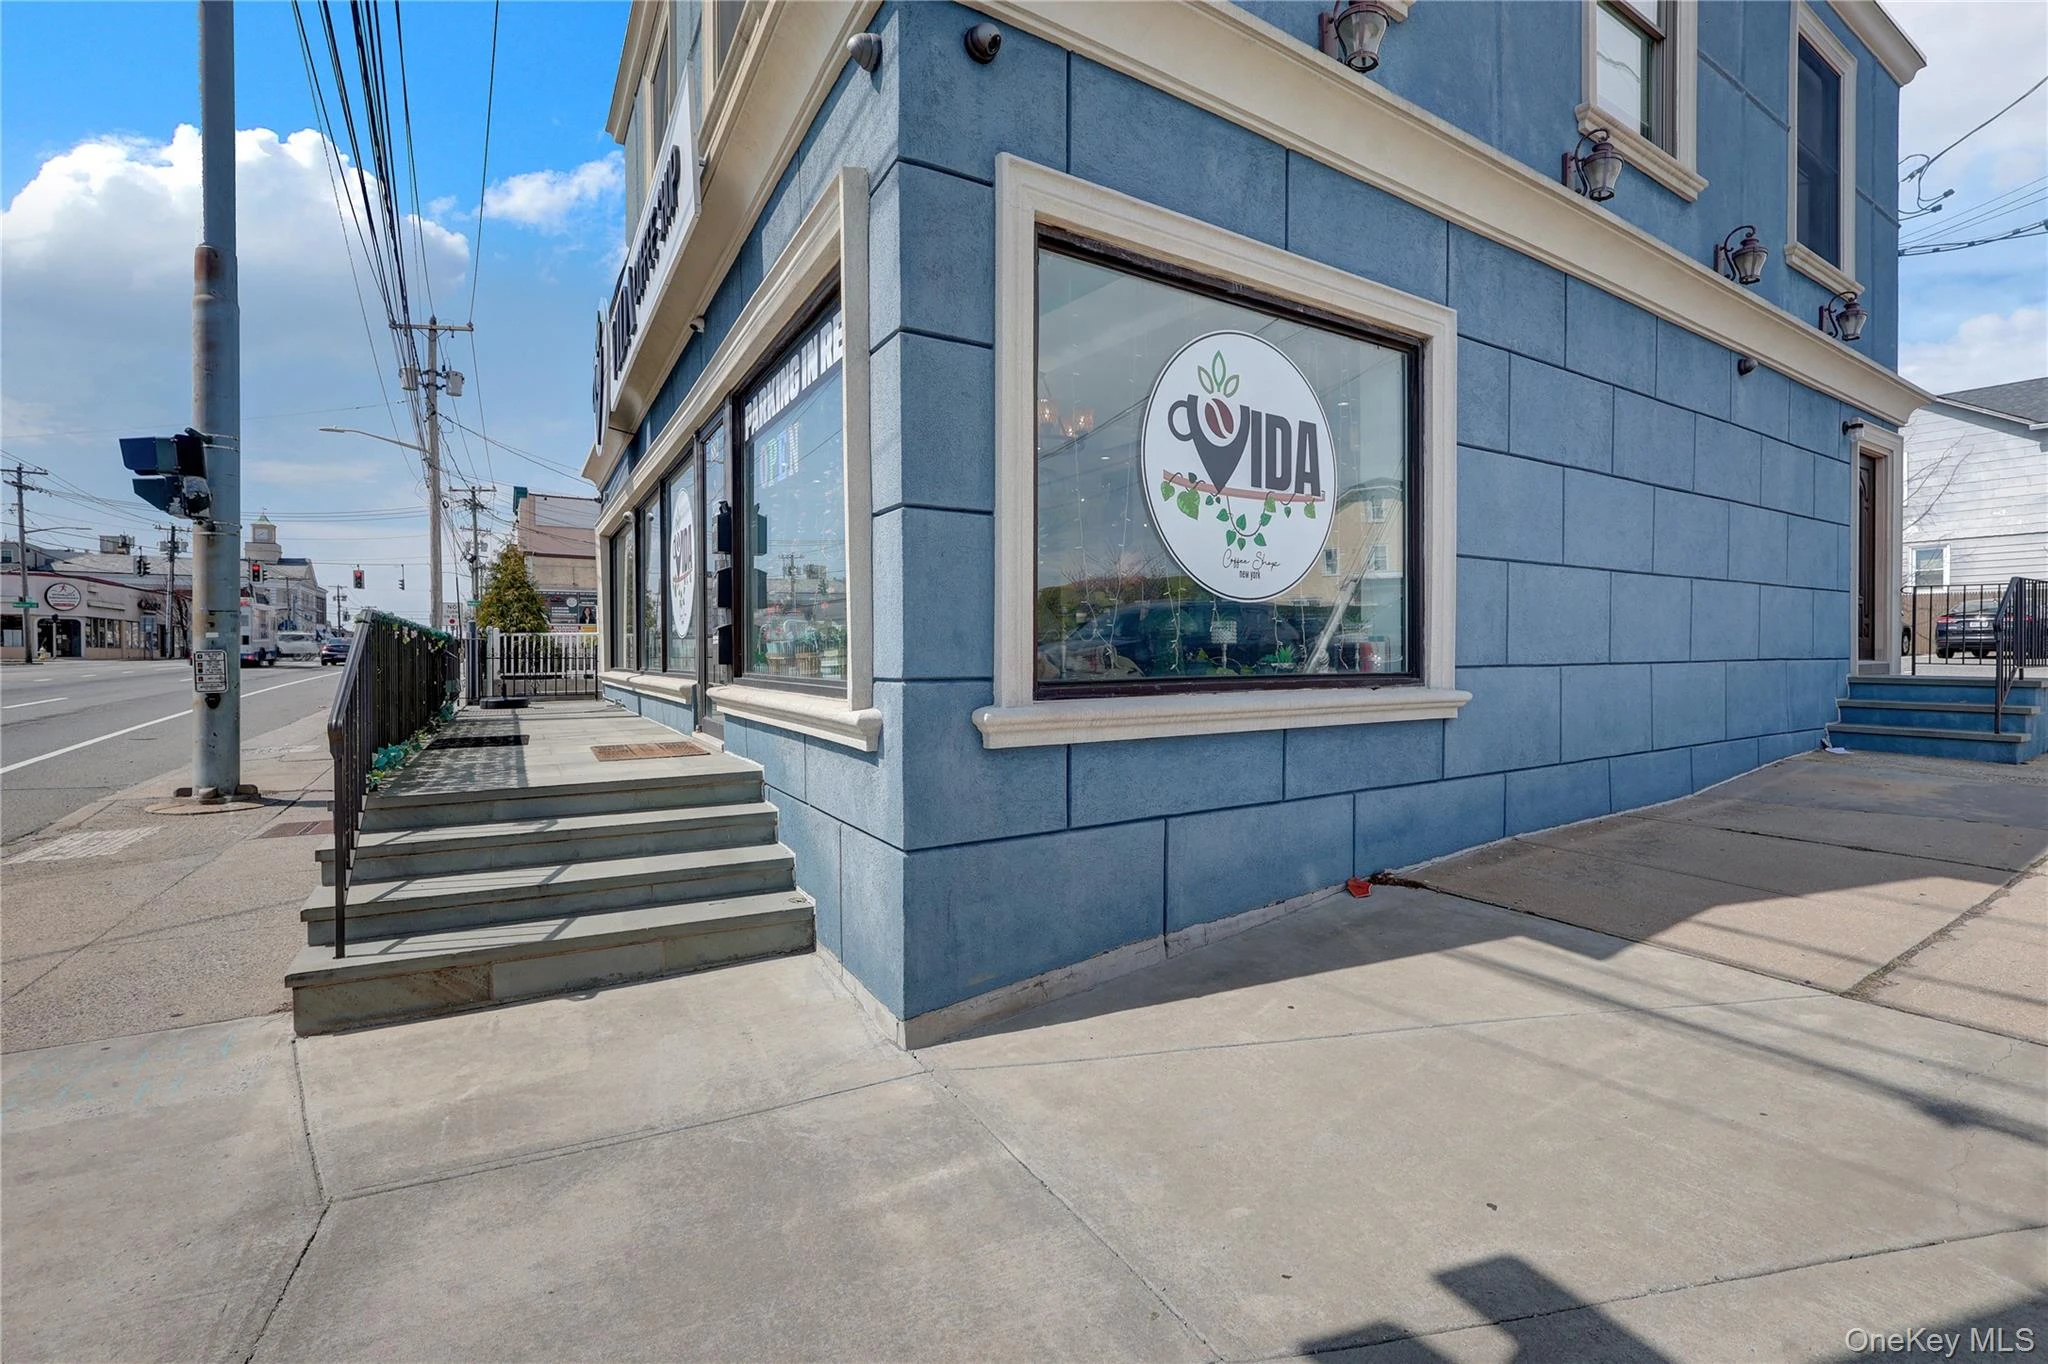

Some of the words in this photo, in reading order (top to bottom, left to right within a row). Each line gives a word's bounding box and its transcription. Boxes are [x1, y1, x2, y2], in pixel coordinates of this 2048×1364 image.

[657, 145, 681, 243] SHOP
[744, 353, 801, 441] PARKING
[801, 333, 819, 391] IN
[1168, 394, 1321, 497] VIDA
[1223, 548, 1250, 569] Coffee
[1252, 551, 1281, 572] Shop
[1239, 570, 1250, 579] new
[1250, 570, 1261, 580] york
